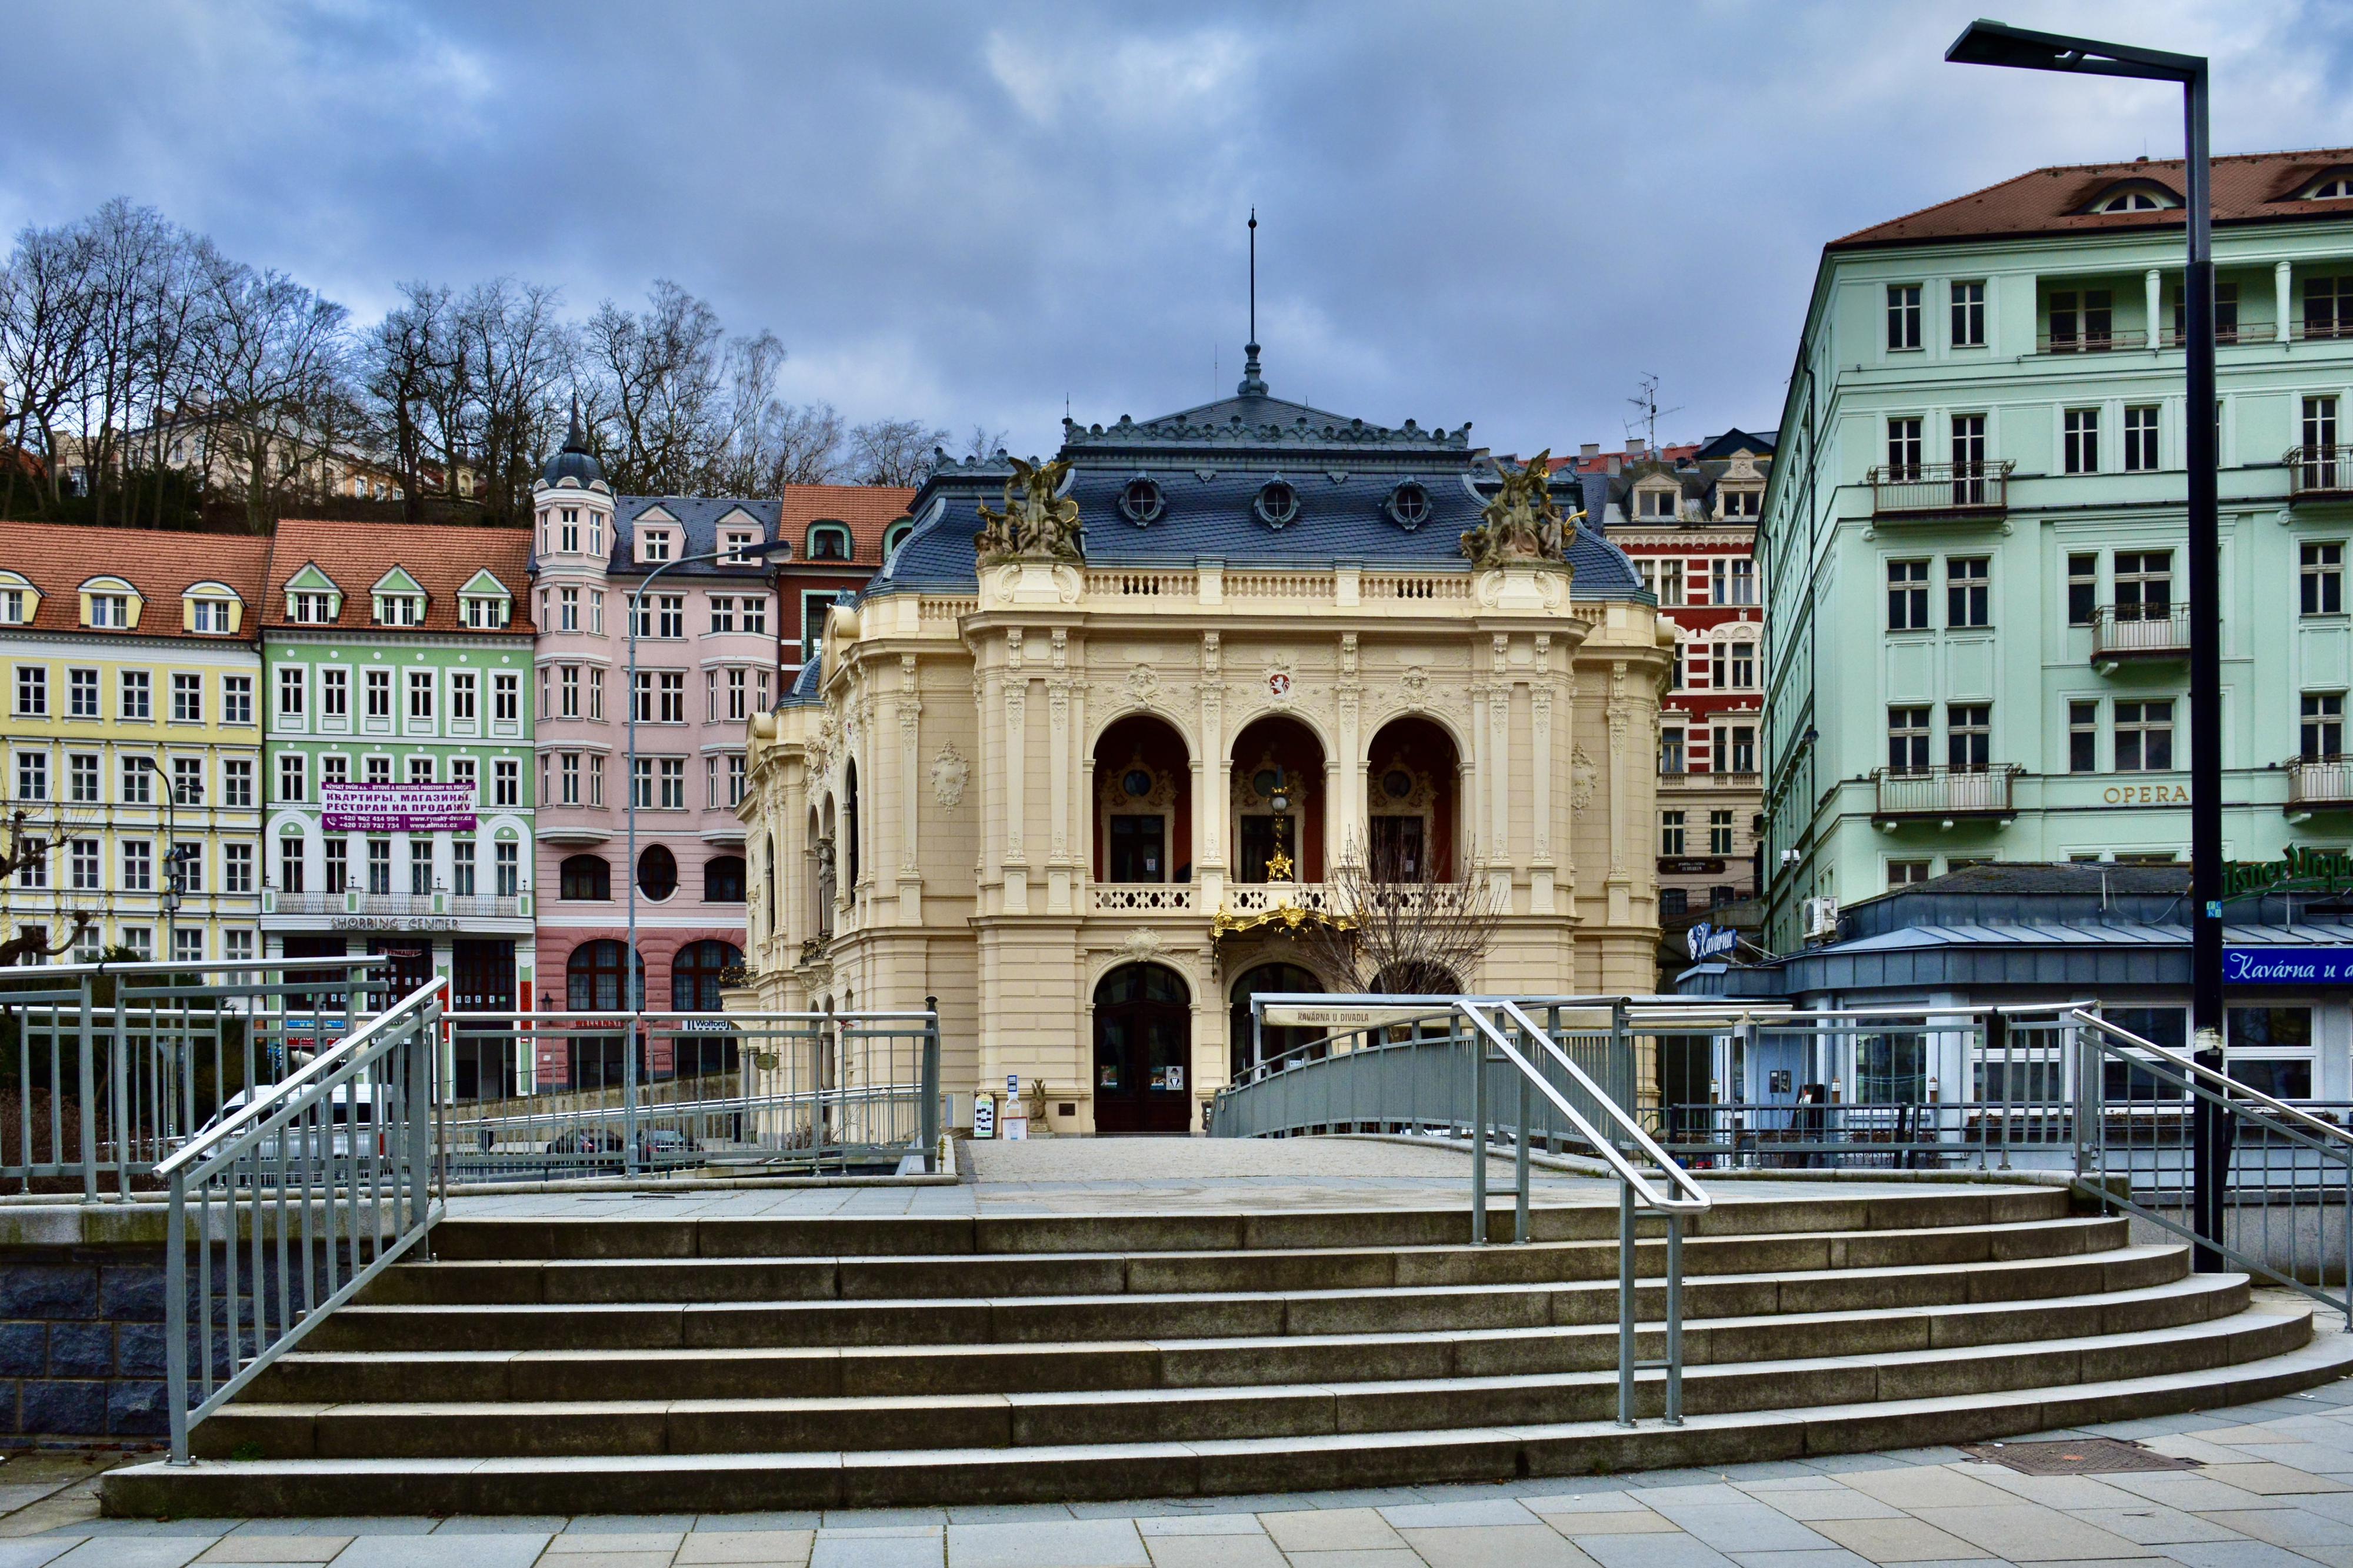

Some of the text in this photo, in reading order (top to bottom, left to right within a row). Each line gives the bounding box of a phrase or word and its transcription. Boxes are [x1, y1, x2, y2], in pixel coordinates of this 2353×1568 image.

[2104, 785, 2189, 804] OPERA
[326, 803, 388, 812] РЕСТОРАН
[412, 803, 470, 812] ПРОДАЖУ
[2221, 842, 2353, 896] ilsner Urqu
[331, 917, 462, 930] SHOPPING CENTER
[1697, 925, 1732, 958] Kavárna
[2229, 952, 2315, 979] Kavárna
[2324, 965, 2337, 978] u
[1298, 1011, 1369, 1022] KAVÁRNA U DIVADLA
